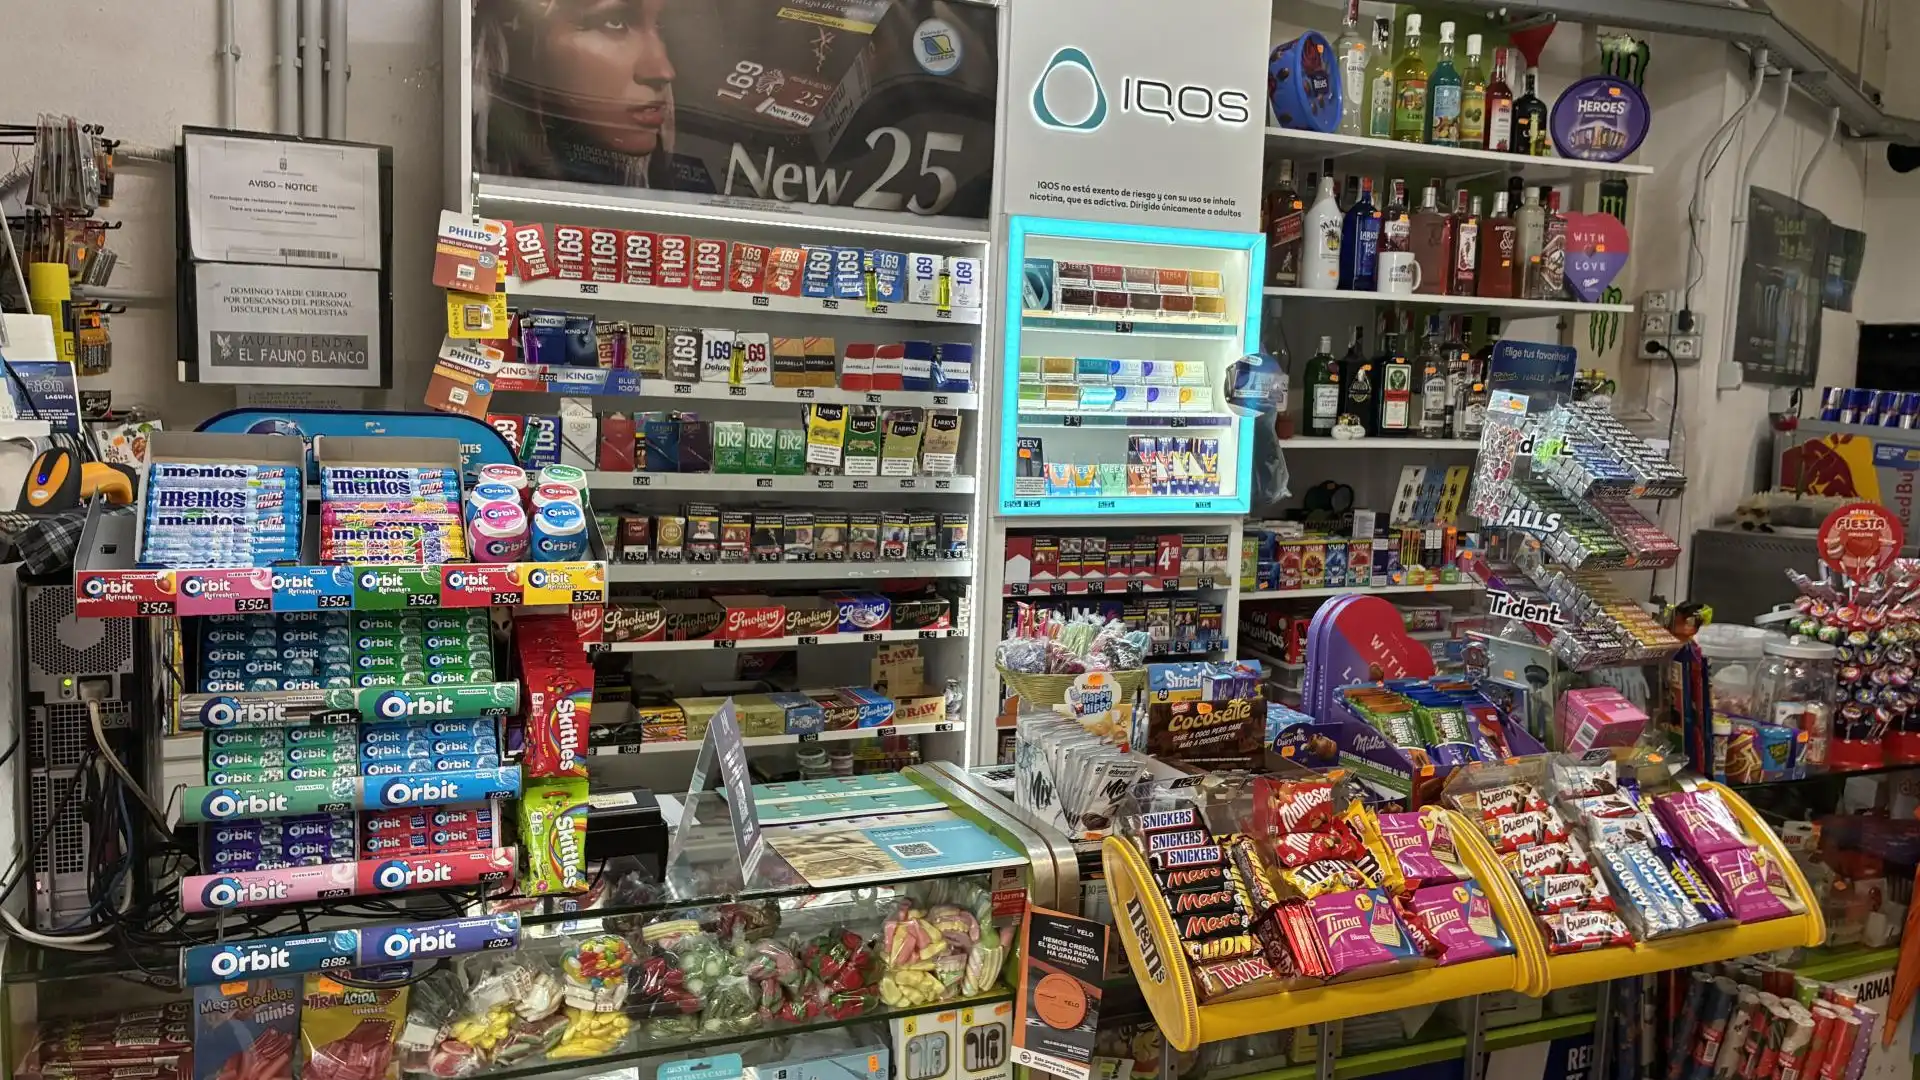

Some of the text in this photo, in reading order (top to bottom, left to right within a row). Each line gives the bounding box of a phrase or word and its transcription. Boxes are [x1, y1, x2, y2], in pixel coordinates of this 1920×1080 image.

[794, 90, 823, 107] 25
[1123, 78, 1249, 123] IQOS
[1577, 100, 1625, 114] HEROES
[770, 105, 811, 123] New Style
[724, 126, 964, 215] New 25
[248, 180, 318, 193] AVISO NOTICE
[1037, 181, 1059, 191] IQOS
[1061, 184, 1071, 192] no
[1073, 184, 1091, 193] está
[1092, 187, 1120, 197] exento
[1121, 187, 1131, 197] de
[1132, 189, 1156, 201] riesgo
[1157, 193, 1162, 202] y
[1163, 193, 1177, 201] con
[1212, 197, 1236, 206] inhala
[1029, 192, 1066, 204] nicotina,
[1067, 196, 1082, 207] que
[1093, 197, 1129, 208] adictiva.
[1130, 200, 1160, 212] Dirigido
[1161, 202, 1206, 215] únicamente
[1213, 208, 1242, 218] adultos
[448, 225, 492, 243] PHILIPS
[1574, 233, 1605, 243] WITH
[479, 255, 490, 264] 32
[1575, 262, 1606, 272] LOVE
[230, 287, 347, 298] DOMINGO TARDE CERRADO
[223, 295, 354, 309] POR DESCANSO DEL PERSONAL
[230, 307, 278, 315] DISCULPEN
[300, 309, 348, 317] MOLESTIAS
[534, 317, 556, 326] KING
[632, 326, 653, 336] NUEVO
[241, 335, 353, 348] MULTITIENDA
[239, 350, 365, 364] EL FAUNO BLANCO
[449, 349, 492, 370] PHILIPS
[1524, 349, 1535, 359] tus
[498, 366, 527, 377] KING
[775, 359, 803, 368] MARBELLA
[806, 359, 834, 368] MARBELLA
[565, 372, 594, 382] KING
[475, 381, 485, 391] 16
[719, 431, 743, 448] DK2
[750, 433, 773, 449] DK2
[780, 434, 801, 450] DK2
[163, 467, 284, 480] mentos mint
[332, 468, 443, 480] mentos mint
[1600, 486, 1630, 497] Trident
[1646, 487, 1674, 497] HALLS
[159, 514, 282, 527] mentos mint
[1836, 518, 1886, 529] FIESTA
[333, 529, 413, 540] mentos
[1637, 558, 1667, 568] HALLS
[87, 577, 134, 594] Orbit
[185, 576, 230, 592] Orbit
[271, 574, 313, 590] Orbit
[361, 573, 403, 587] Orbit
[449, 572, 488, 587] Orbit
[531, 571, 570, 585] Orbit
[1487, 591, 1564, 626] Trident
[604, 608, 660, 632] Smoking
[729, 610, 780, 632] Smoking
[787, 609, 832, 629] Smoking
[880, 649, 917, 665] RAW
[1370, 634, 1406, 680] WITH
[207, 702, 288, 729] Orbit
[381, 698, 453, 718] Orbit
[825, 706, 858, 723] Smoking
[860, 703, 892, 719] Smoking
[907, 703, 938, 718] RAW
[1168, 704, 1251, 732] Cocosette
[556, 699, 579, 771] Skittles
[1172, 732, 1189, 741] SABE
[1195, 729, 1210, 737] COCO
[1211, 725, 1226, 733] PERO
[1228, 722, 1243, 731] SABE
[1352, 734, 1385, 751] Milka
[386, 781, 459, 803] Orbit
[1480, 788, 1512, 806] bueno
[209, 792, 288, 817] Orbit
[1280, 787, 1333, 832] Malteser
[1143, 811, 1192, 828] SNICKERS
[1502, 814, 1534, 834] bueno
[1152, 831, 1202, 849] SNICKERS
[1385, 832, 1422, 851] Tirma
[556, 815, 576, 889] Skittles
[1169, 848, 1219, 865] SNICKERS
[1523, 847, 1556, 868] bueno
[381, 865, 451, 887] Orbit
[1168, 868, 1221, 888] Mars
[1607, 852, 1652, 906] BOUNTY
[210, 881, 289, 905] Orbit
[1547, 878, 1580, 895] bueno
[993, 891, 1026, 902] Alarma
[1177, 891, 1232, 912] Mars
[1318, 911, 1362, 935] Tirma
[1417, 905, 1460, 928] Tirma
[1077, 928, 1094, 938] VELO
[1186, 913, 1240, 938] Mars
[1038, 940, 1100, 962] EL EQUIPO PAPAYA
[1043, 936, 1096, 955] HEMOS CREÍDO.
[1201, 936, 1252, 960] LION
[211, 949, 290, 975] Orbit
[1058, 953, 1089, 965] GANADO.
[307, 992, 338, 1011] TIRA
[254, 1004, 296, 1024] minis
